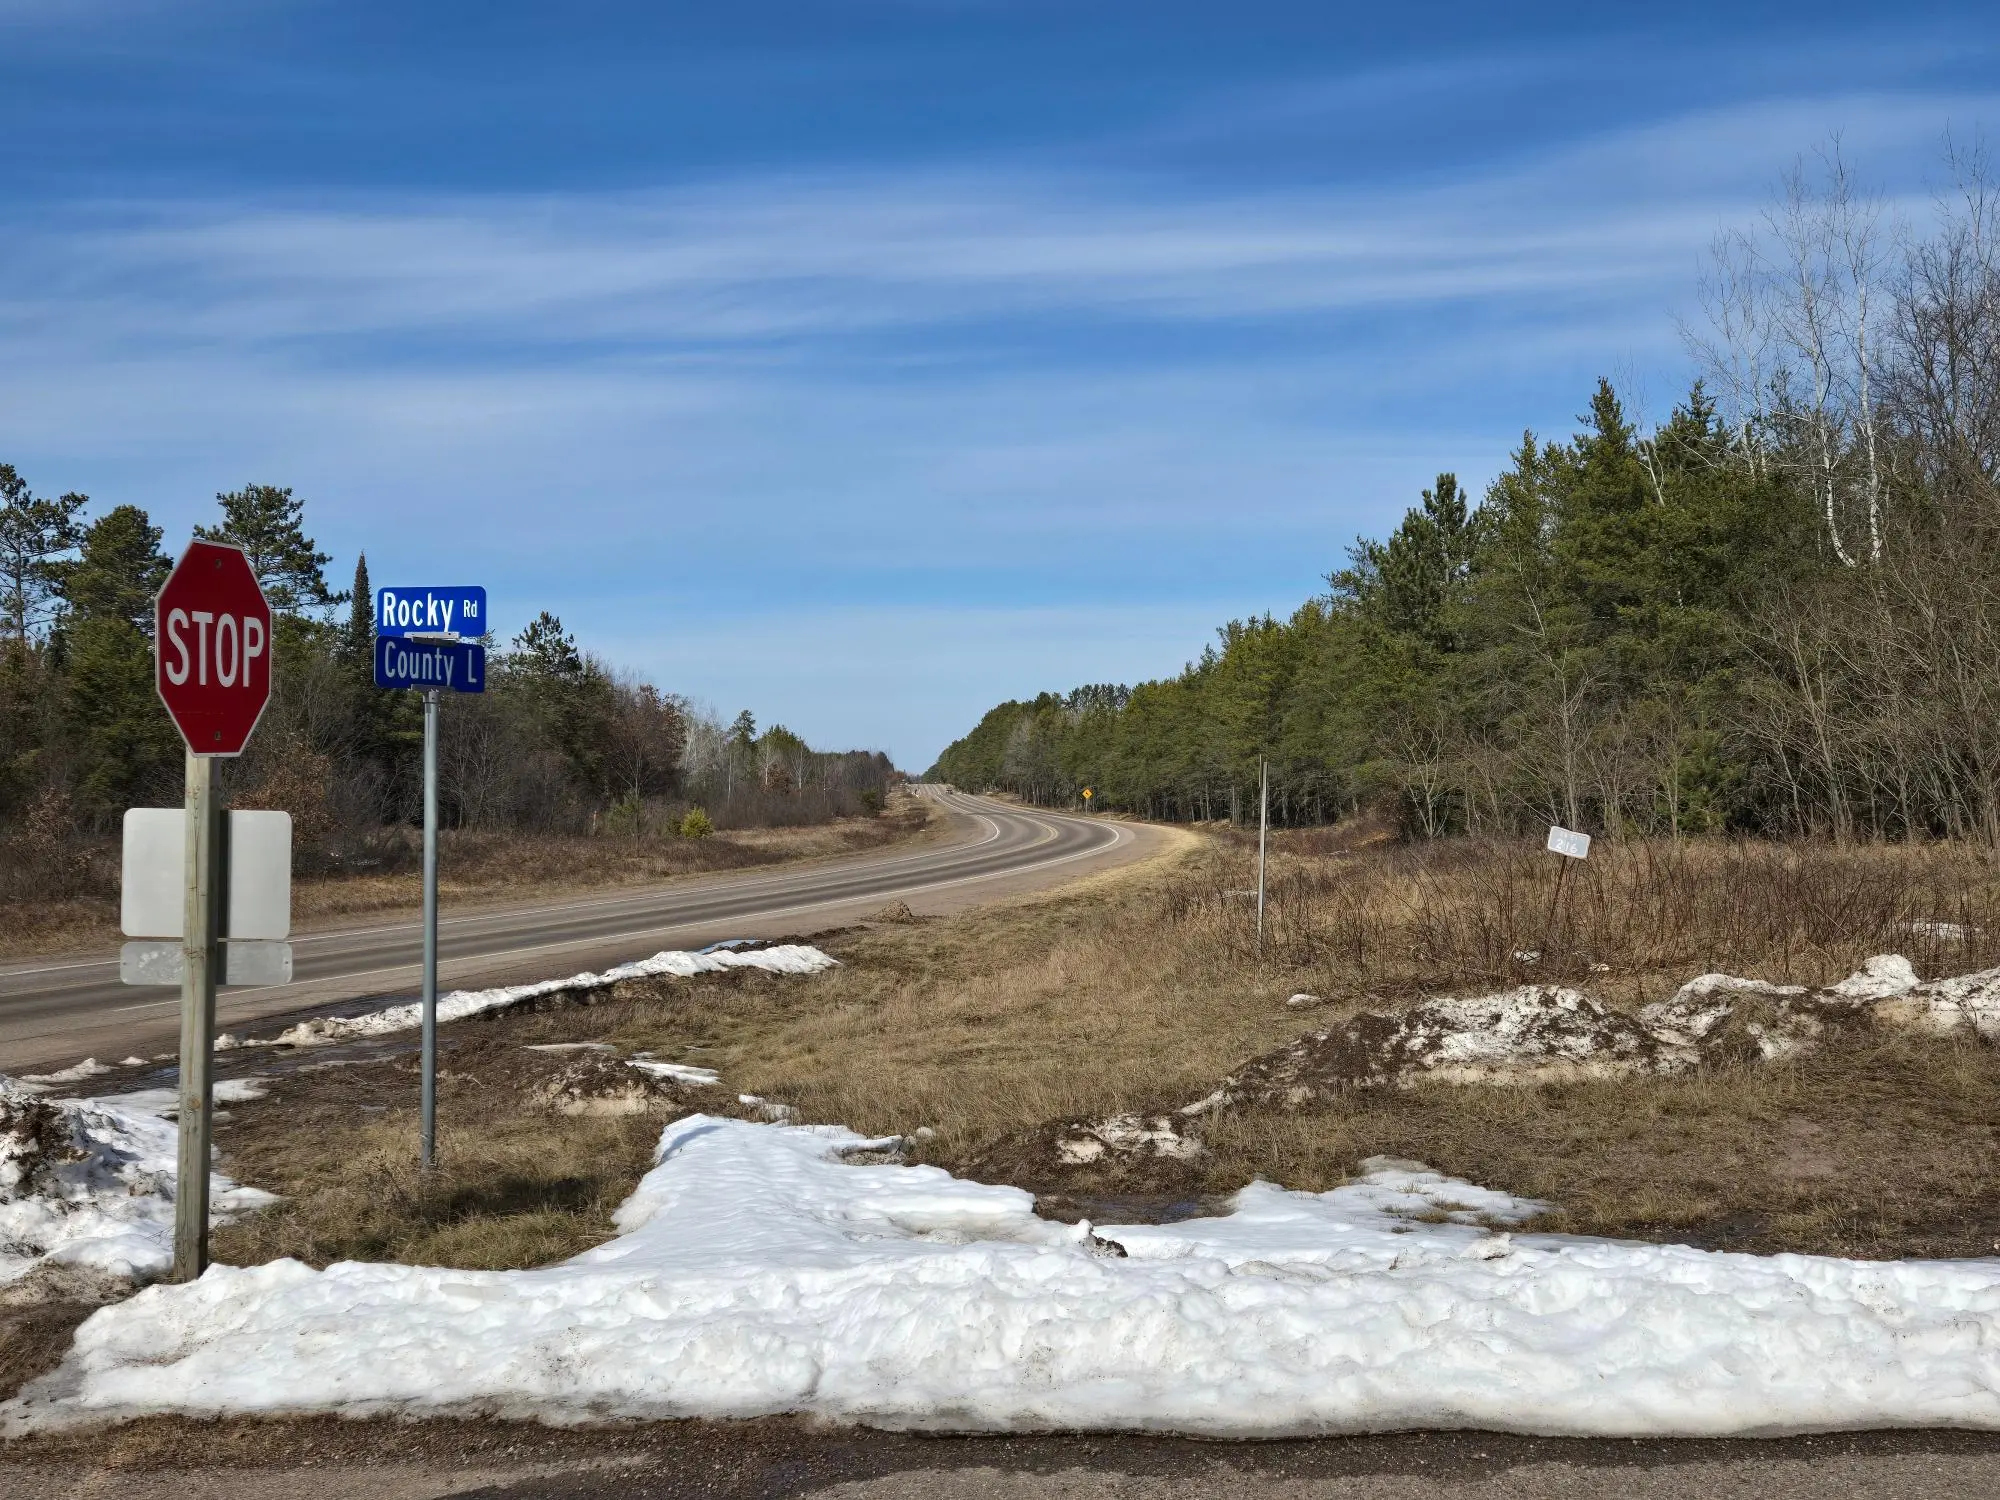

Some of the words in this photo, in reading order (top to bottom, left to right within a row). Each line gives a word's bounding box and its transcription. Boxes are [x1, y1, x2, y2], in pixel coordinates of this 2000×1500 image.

[383, 592, 454, 632] Rocky
[463, 599, 478, 618] Rd
[165, 608, 264, 688] STOP
[385, 641, 454, 687] County
[467, 649, 478, 683] L
